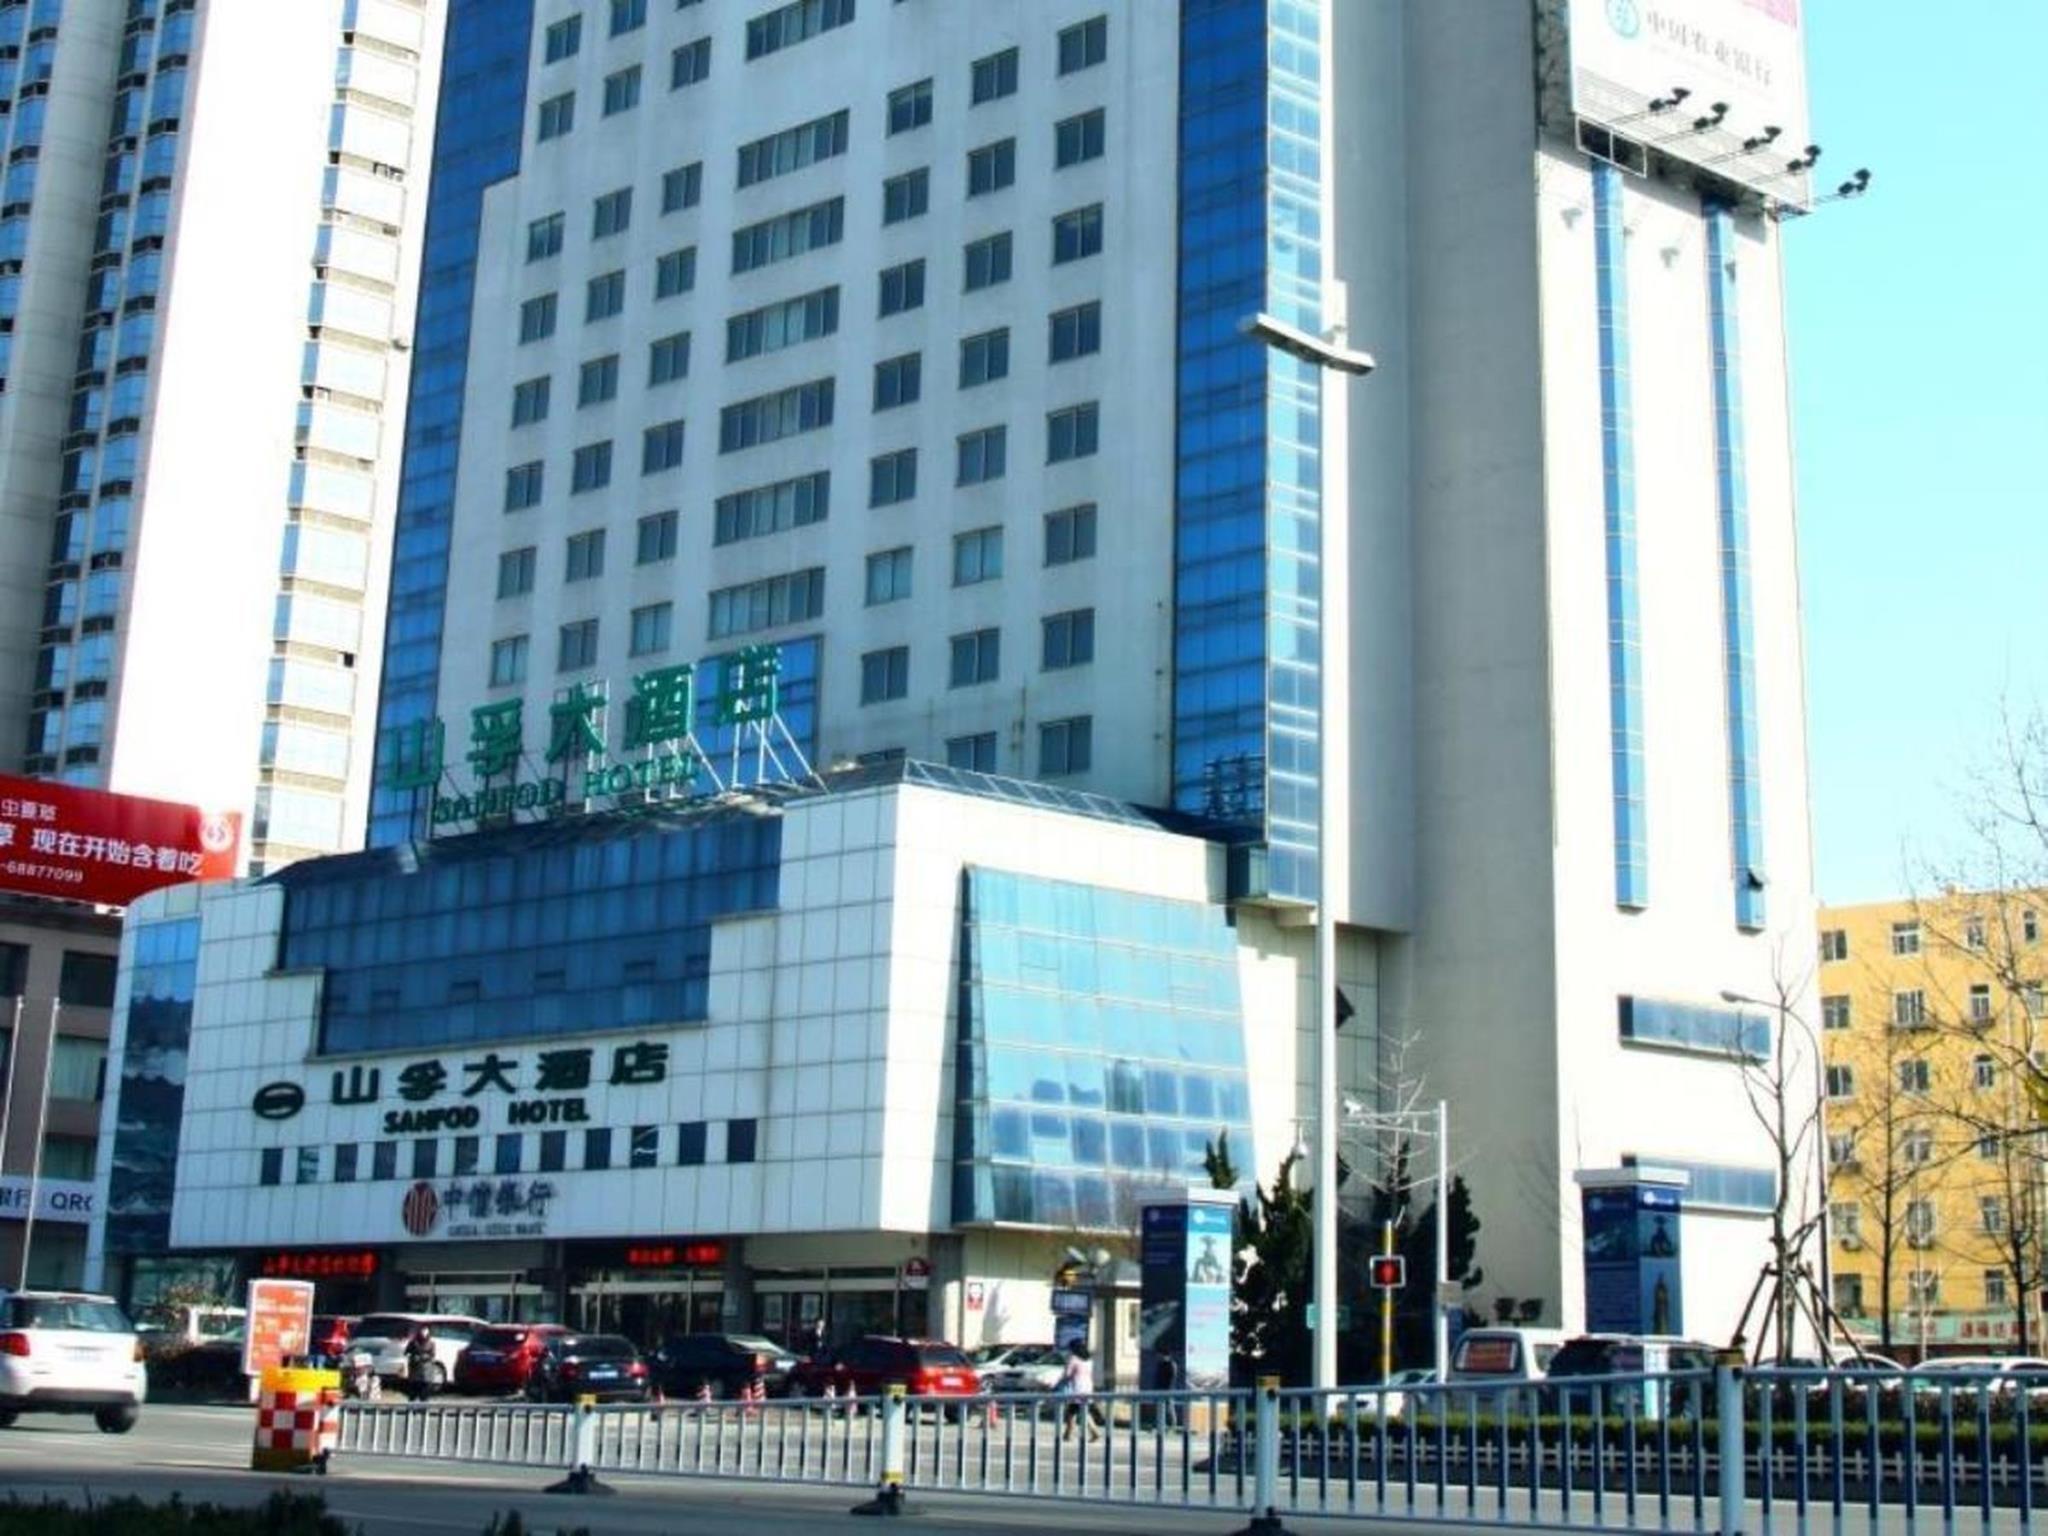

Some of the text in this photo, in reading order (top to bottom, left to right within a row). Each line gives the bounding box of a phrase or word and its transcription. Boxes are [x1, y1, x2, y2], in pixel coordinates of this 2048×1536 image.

[583, 751, 698, 798] HOTEL
[31, 827, 204, 876] 现在开始含着吃
[332, 1042, 669, 1106] 山孚大酒店
[508, 1098, 591, 1125] HOTEL
